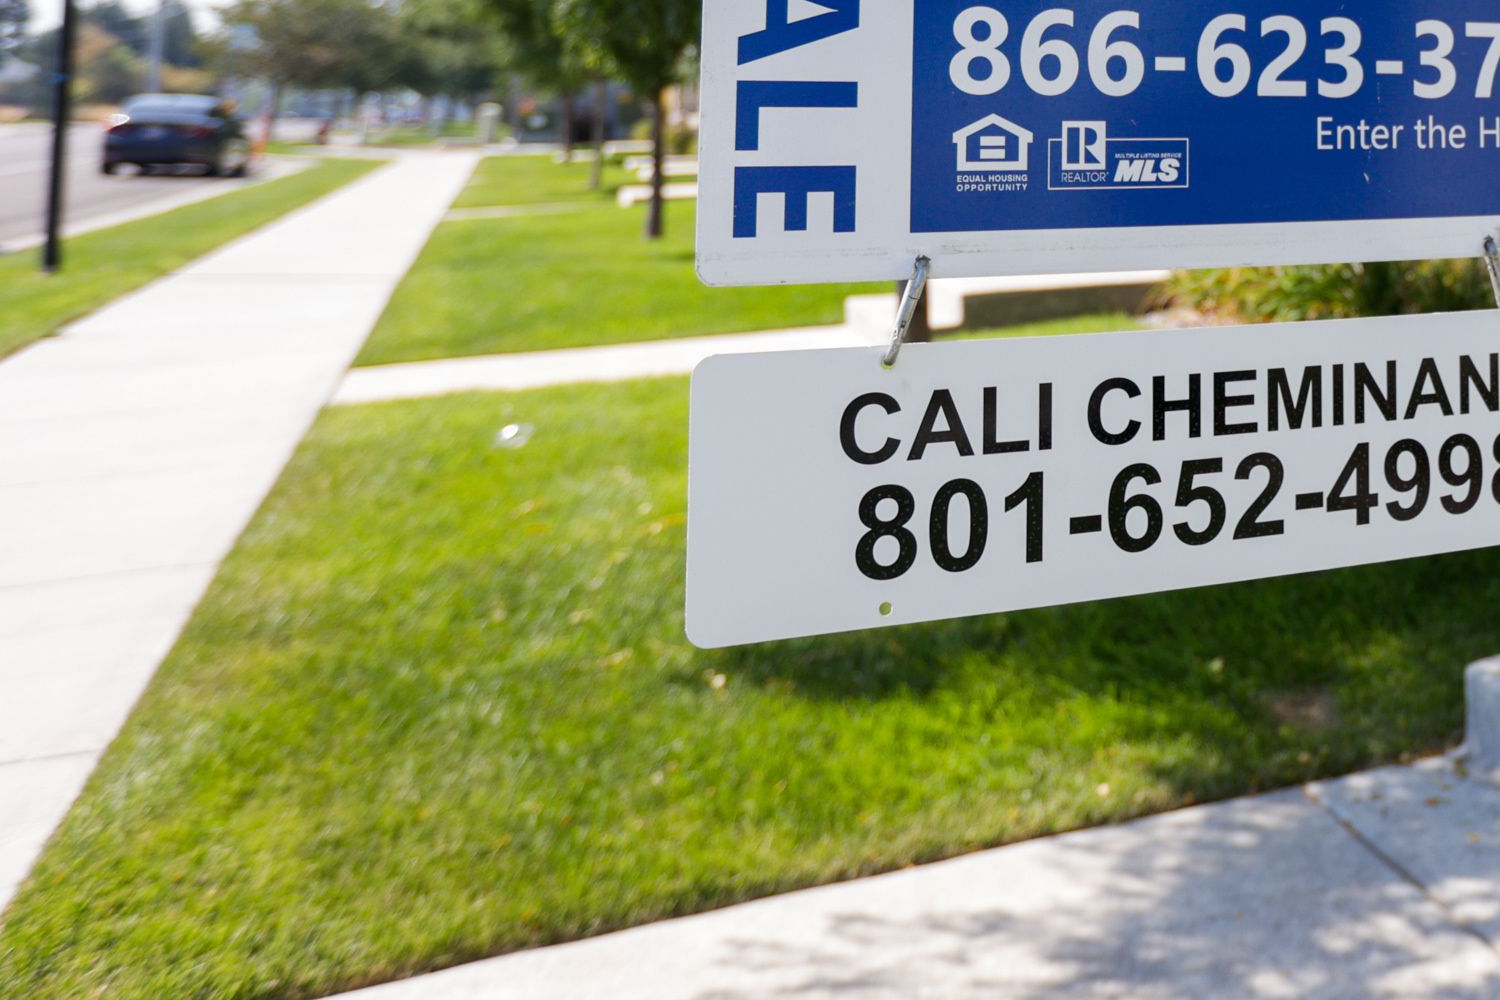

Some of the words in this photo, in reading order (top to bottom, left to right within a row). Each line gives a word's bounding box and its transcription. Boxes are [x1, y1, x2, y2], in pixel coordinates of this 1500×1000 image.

[1317, 115, 1404, 150] Enter
[1414, 115, 1467, 149] the
[957, 175, 986, 183] EQUAL
[988, 174, 1028, 183] HOUSING
[1113, 158, 1181, 182] MLS
[956, 183, 1028, 192] OPPORTUNITY
[839, 382, 1053, 465] CALI
